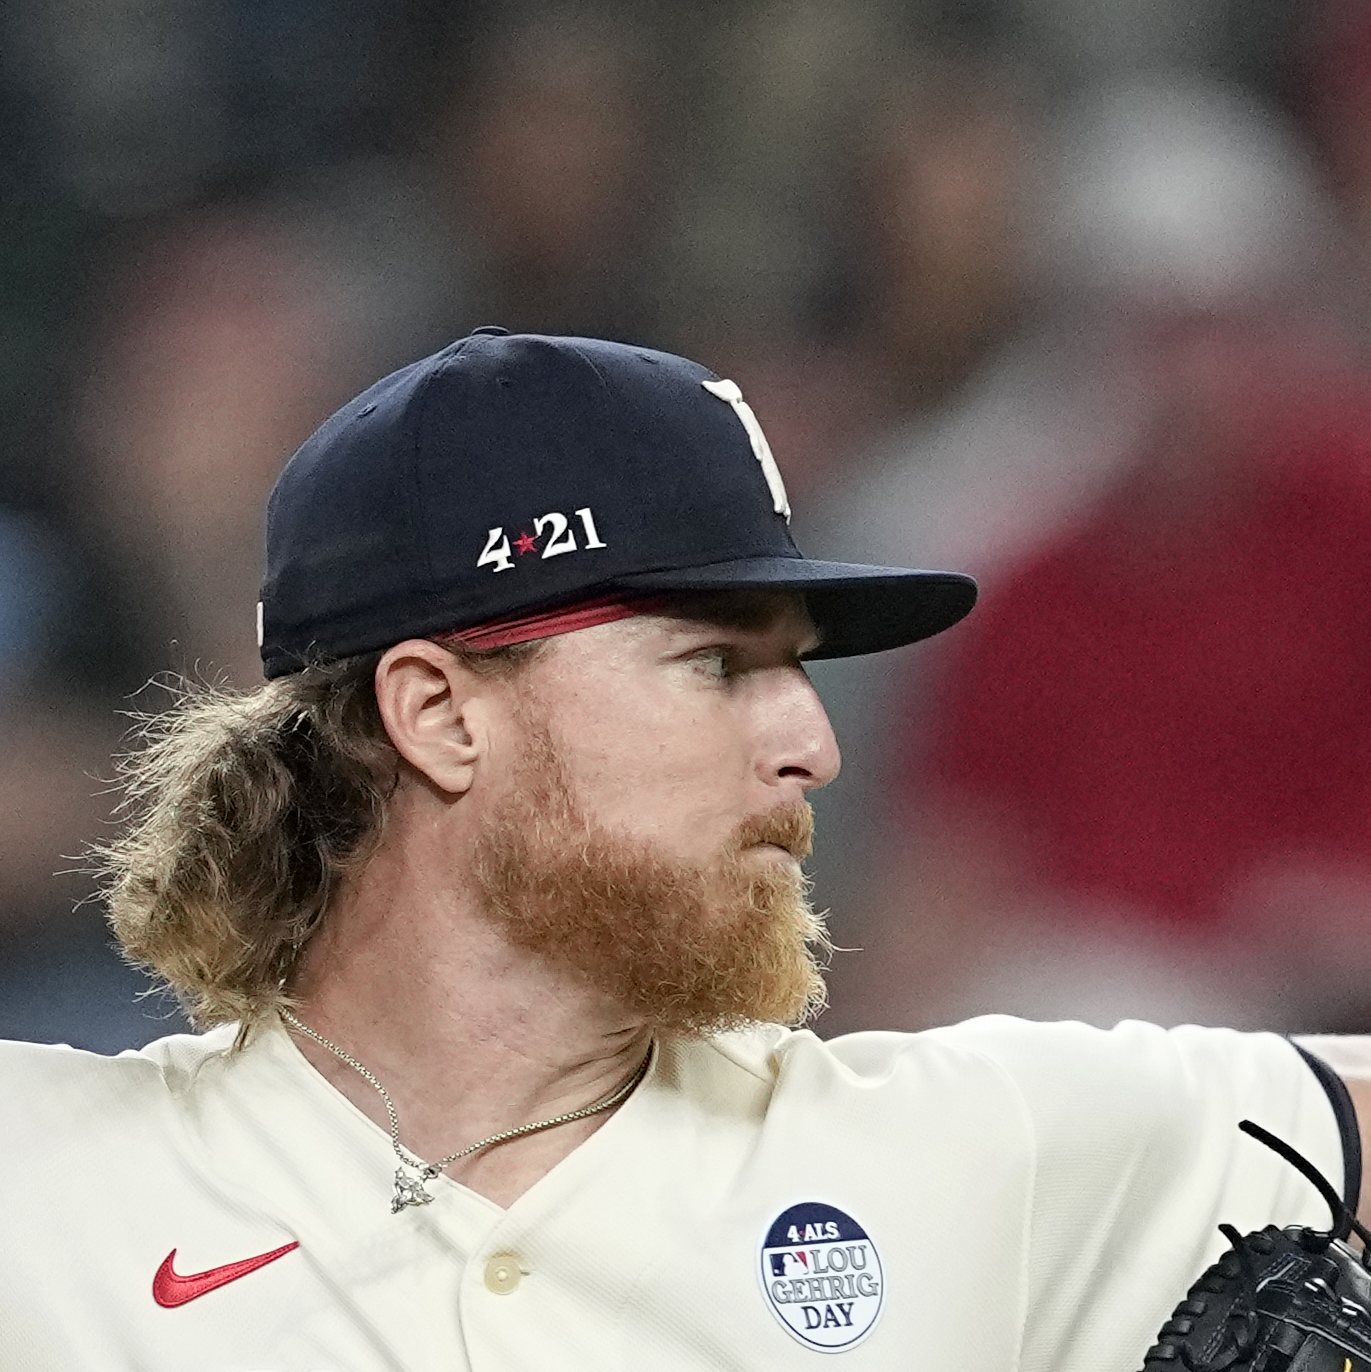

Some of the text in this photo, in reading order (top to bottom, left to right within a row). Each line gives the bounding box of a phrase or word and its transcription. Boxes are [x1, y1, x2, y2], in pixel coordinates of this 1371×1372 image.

[810, 1245, 867, 1275] LOU
[772, 1273, 879, 1304] GEHRIG
[801, 1302, 855, 1330] DAY
